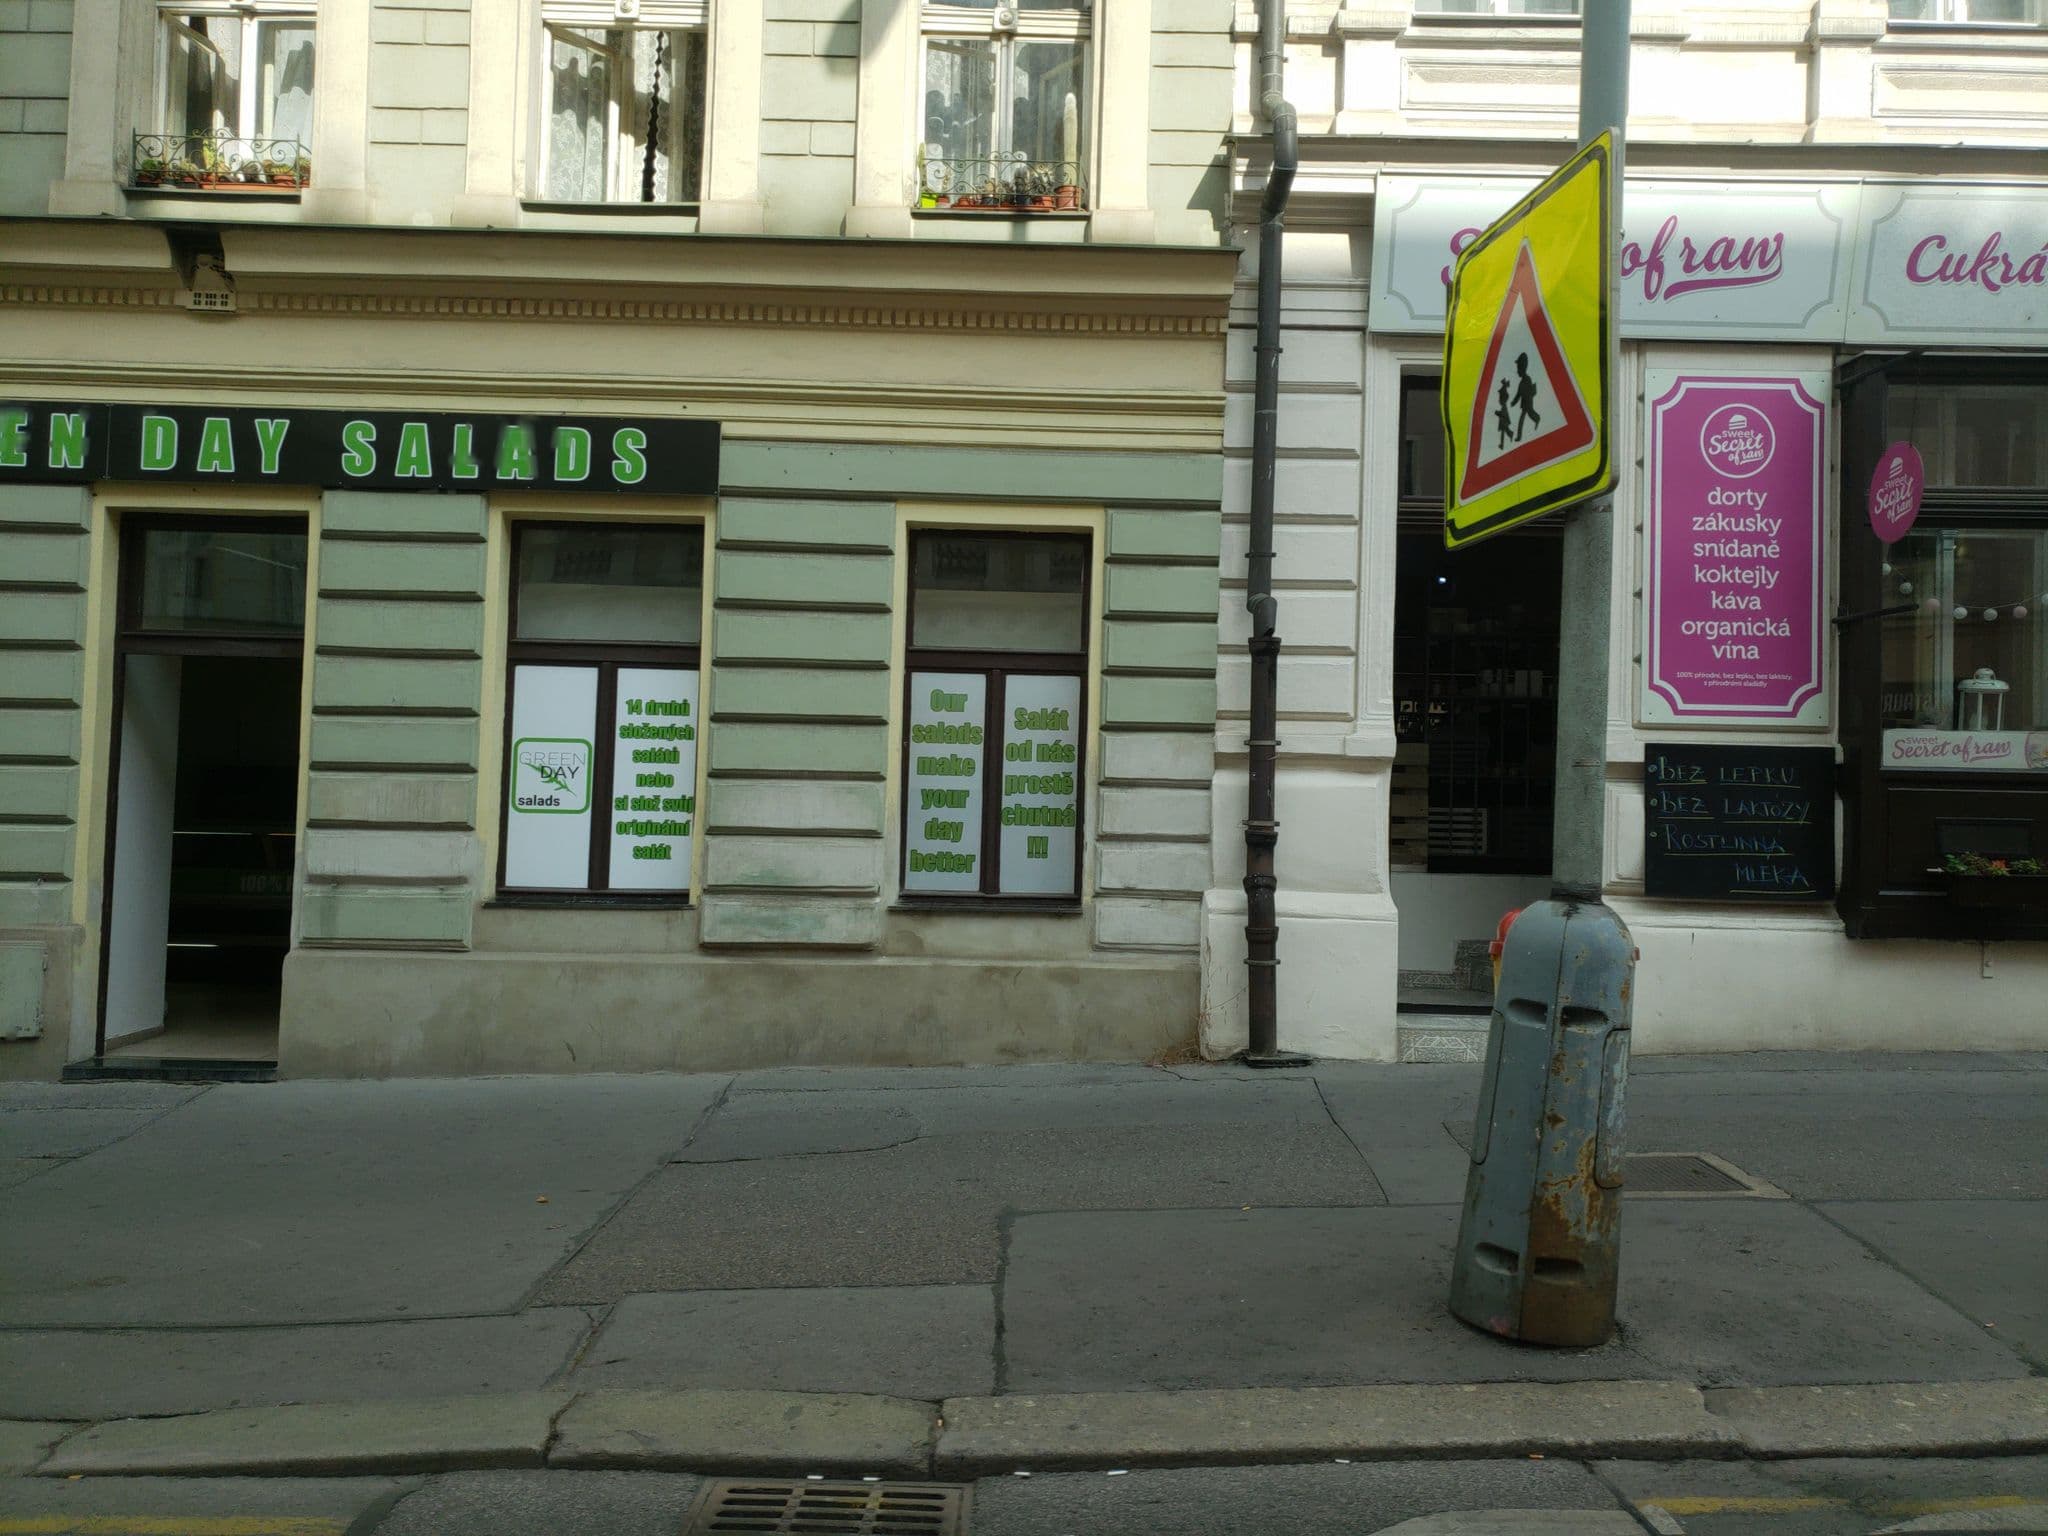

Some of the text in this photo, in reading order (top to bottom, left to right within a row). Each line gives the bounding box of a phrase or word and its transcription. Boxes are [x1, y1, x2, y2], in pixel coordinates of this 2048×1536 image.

[1664, 231, 1785, 301] raw
[1906, 231, 2048, 292] Cukrá
[1709, 433, 1764, 455] Secret
[1722, 429, 1754, 438] sweet
[140, 415, 290, 474] DAY
[342, 420, 647, 484] SALADS
[1728, 449, 1765, 466] of raw
[1707, 487, 1768, 511] dorty
[1692, 513, 1782, 538] zákusky
[1693, 538, 1780, 559] snídaně
[1694, 564, 1780, 589] koktejly
[1711, 590, 1762, 611] káva
[1681, 617, 1791, 641] organická
[1711, 641, 1760, 661] vína
[625, 699, 691, 716] 14 druhů
[930, 689, 968, 712] Our
[1014, 707, 1070, 731] Salát
[619, 723, 695, 741] složených
[912, 722, 983, 745] salads
[519, 751, 586, 766] GREEN
[632, 746, 680, 764] salátů
[1005, 740, 1075, 763] od nás
[1892, 736, 2012, 762] Secret of raw
[540, 765, 581, 779] DAY
[917, 754, 976, 776] make
[636, 771, 675, 788] nebo
[1005, 772, 1074, 795] prostě
[518, 795, 561, 807] salads
[615, 795, 629, 810] si
[630, 795, 661, 811] slož
[920, 787, 970, 810] your
[1001, 804, 1075, 827] chutná
[616, 819, 691, 837] originální
[924, 818, 963, 843] day
[633, 843, 672, 860] salát
[1027, 836, 1049, 859] !!!
[910, 849, 976, 873] better
